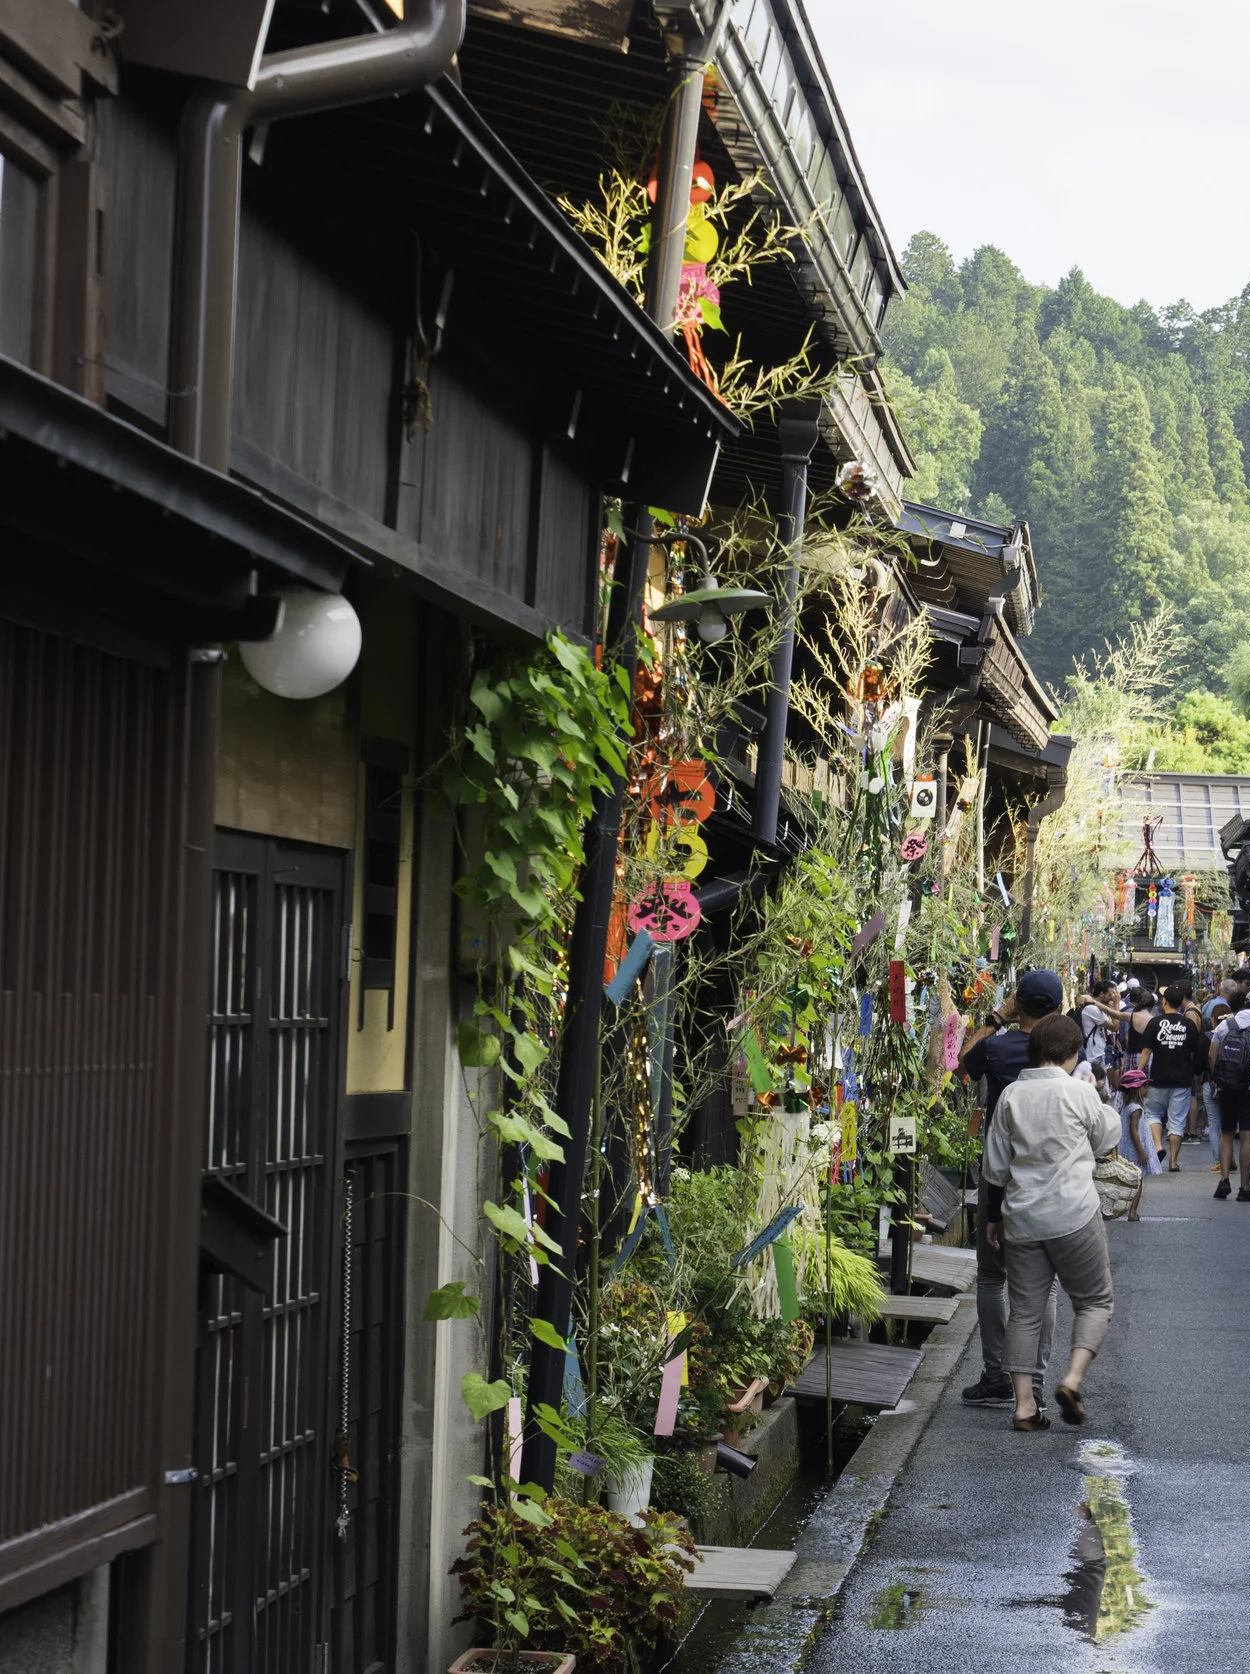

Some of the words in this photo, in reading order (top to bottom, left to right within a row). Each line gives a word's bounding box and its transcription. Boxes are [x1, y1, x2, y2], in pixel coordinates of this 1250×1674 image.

[904, 838, 925, 858] 祭
[635, 894, 694, 934] 祭
[1159, 1019, 1187, 1034] Rodeo
